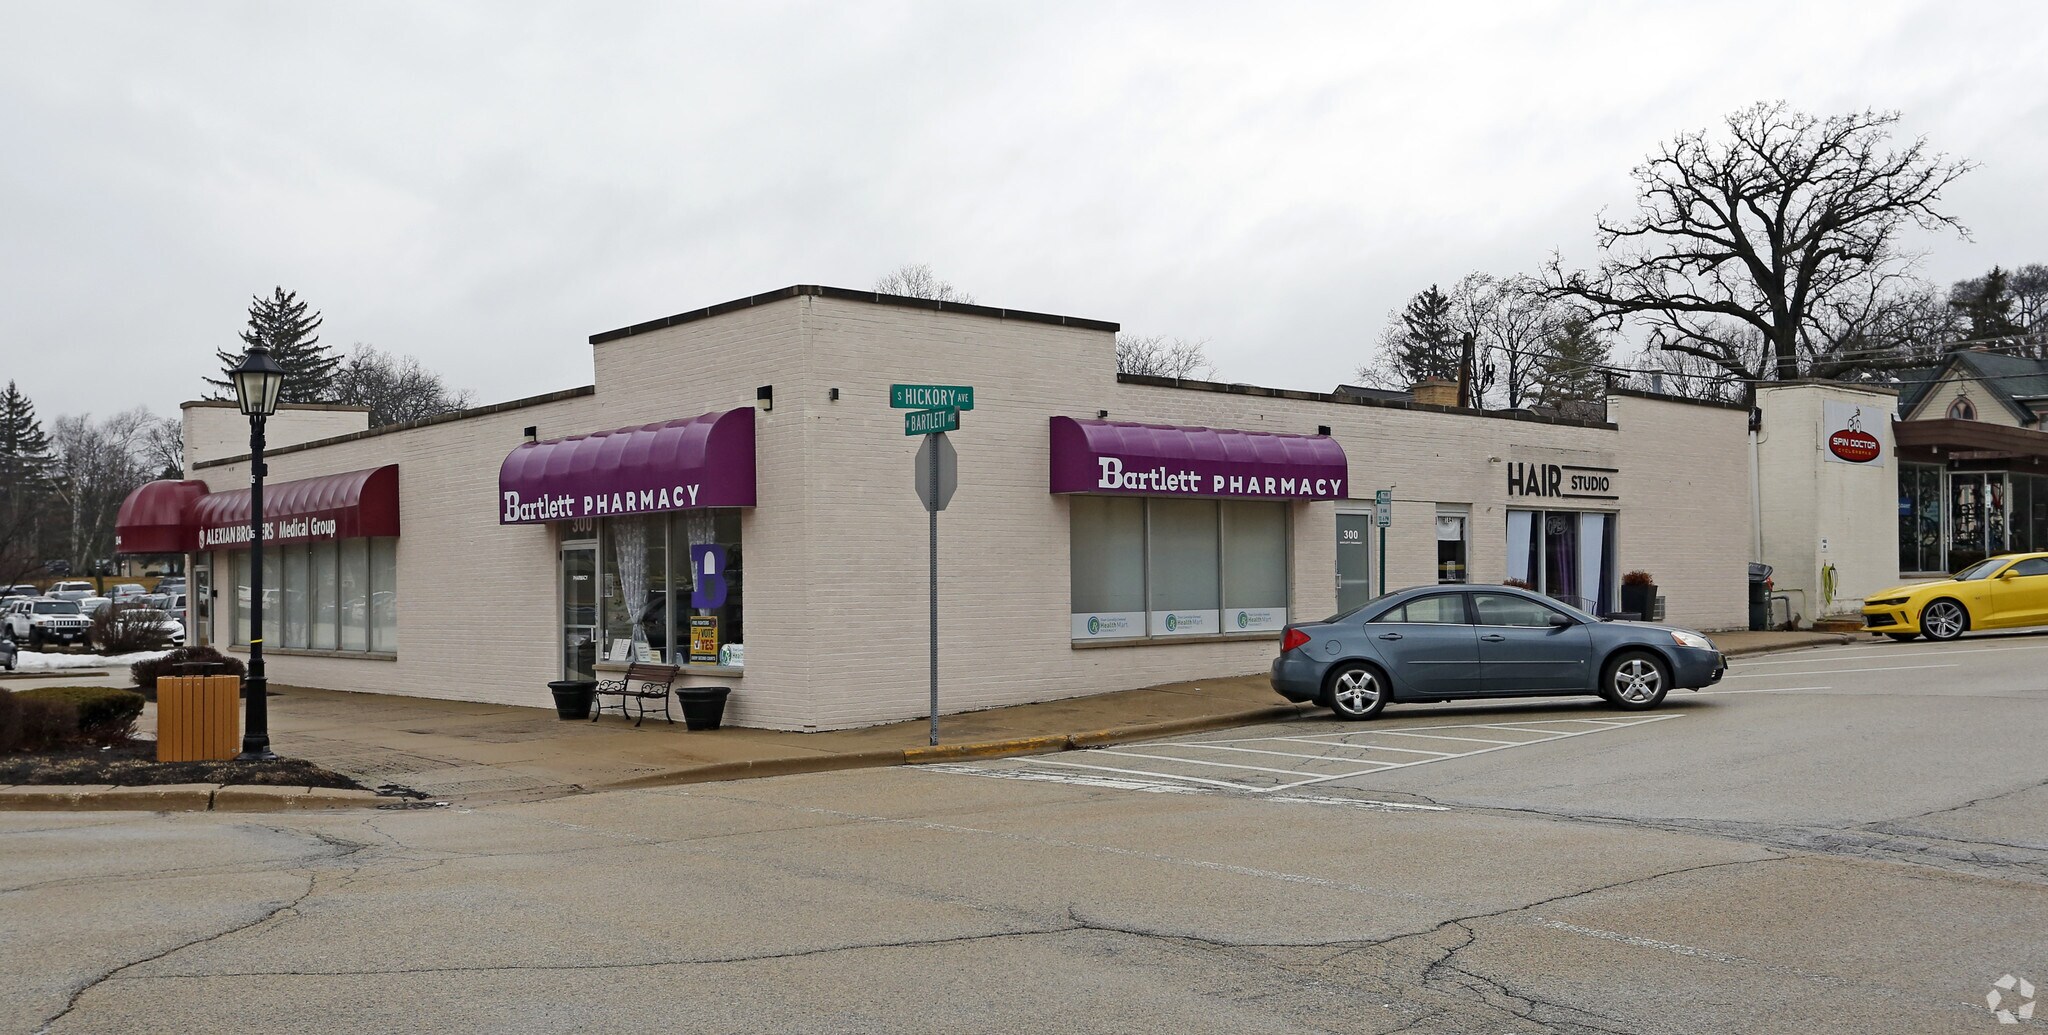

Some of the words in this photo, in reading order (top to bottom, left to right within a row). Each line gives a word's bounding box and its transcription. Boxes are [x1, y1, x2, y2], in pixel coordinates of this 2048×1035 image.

[897, 391, 902, 401] S
[905, 388, 955, 406] HICKORY
[957, 393, 969, 403] AVE
[911, 411, 945, 431] BARTLETT
[1832, 437, 1849, 446] SPIN
[1850, 439, 1877, 449] DOCTOR
[1098, 456, 1202, 492] Bartlett
[1213, 475, 1342, 496] PHARMACY
[1507, 462, 1562, 497] HAIR
[1572, 475, 1609, 491] STUDIO
[504, 491, 575, 522] Bartlett
[583, 484, 700, 515] PHARMACY
[206, 526, 236, 545] ALEXIAN
[236, 522, 274, 543] BROERS
[278, 517, 309, 539] Medical
[310, 516, 336, 538] Group
[1343, 530, 1359, 540] 300
[701, 628, 714, 638] VOTE
[701, 639, 714, 651] YES
